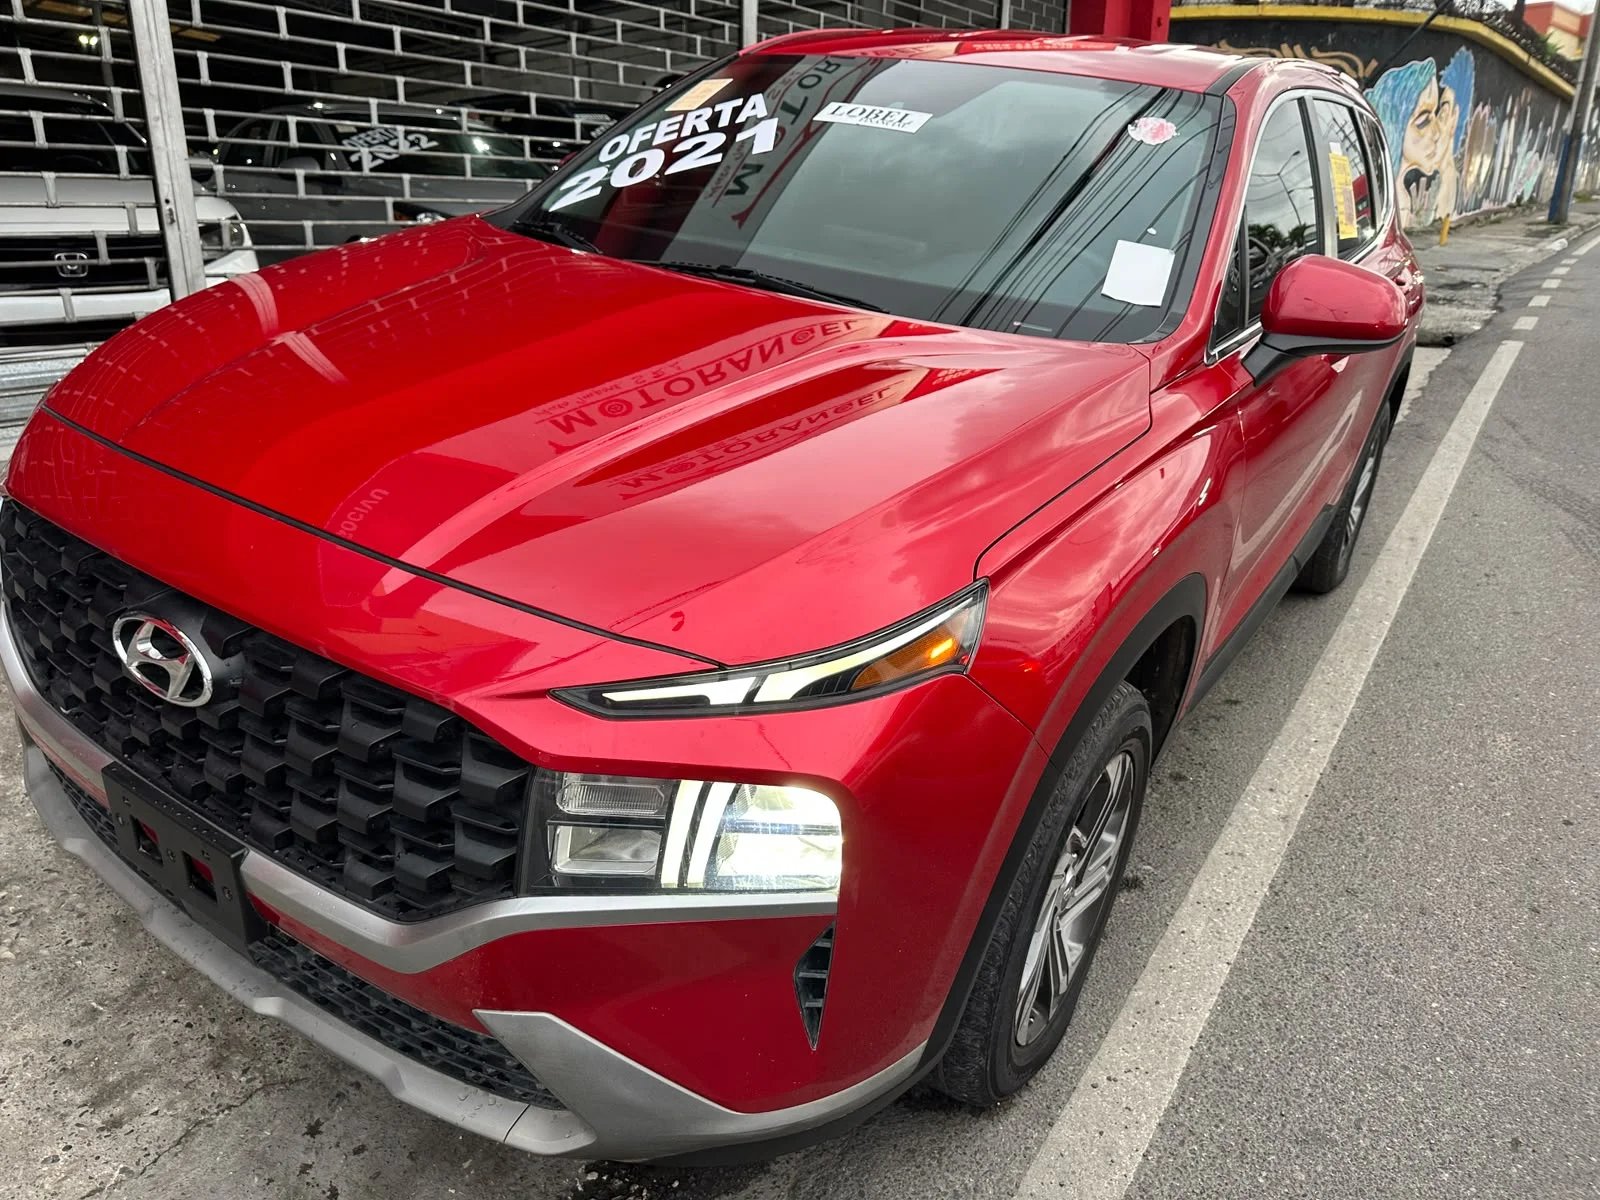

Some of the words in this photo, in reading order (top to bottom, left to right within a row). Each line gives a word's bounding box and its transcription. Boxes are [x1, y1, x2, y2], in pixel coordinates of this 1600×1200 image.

[599, 93, 768, 162] OFERTA
[830, 106, 913, 124] LOBEL
[548, 118, 778, 212] 2021
